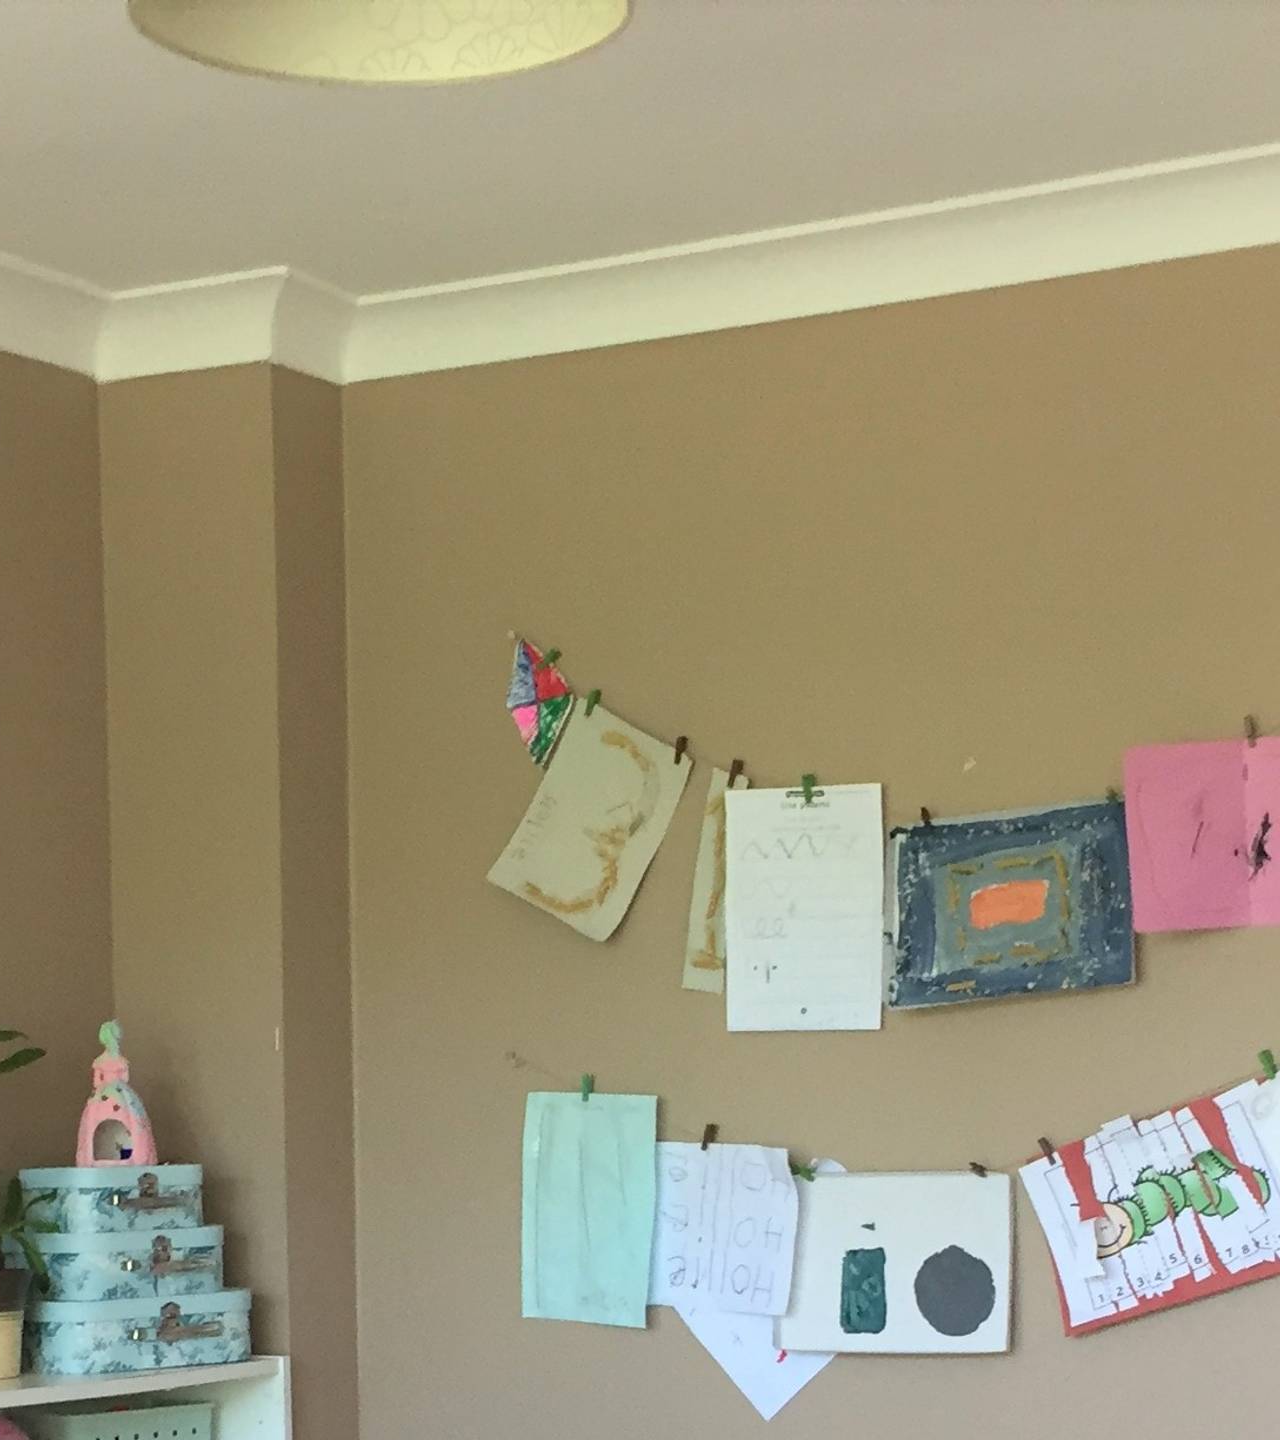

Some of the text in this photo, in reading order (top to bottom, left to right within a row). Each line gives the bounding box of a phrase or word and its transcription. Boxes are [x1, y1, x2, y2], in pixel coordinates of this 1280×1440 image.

[1116, 1286, 1124, 1297] 2
[1136, 1276, 1145, 1288] 3
[1169, 1253, 1179, 1264] 5
[1193, 1254, 1204, 1265] 6
[1225, 1246, 1233, 1258] 7
[1241, 1244, 1250, 1255] 8
